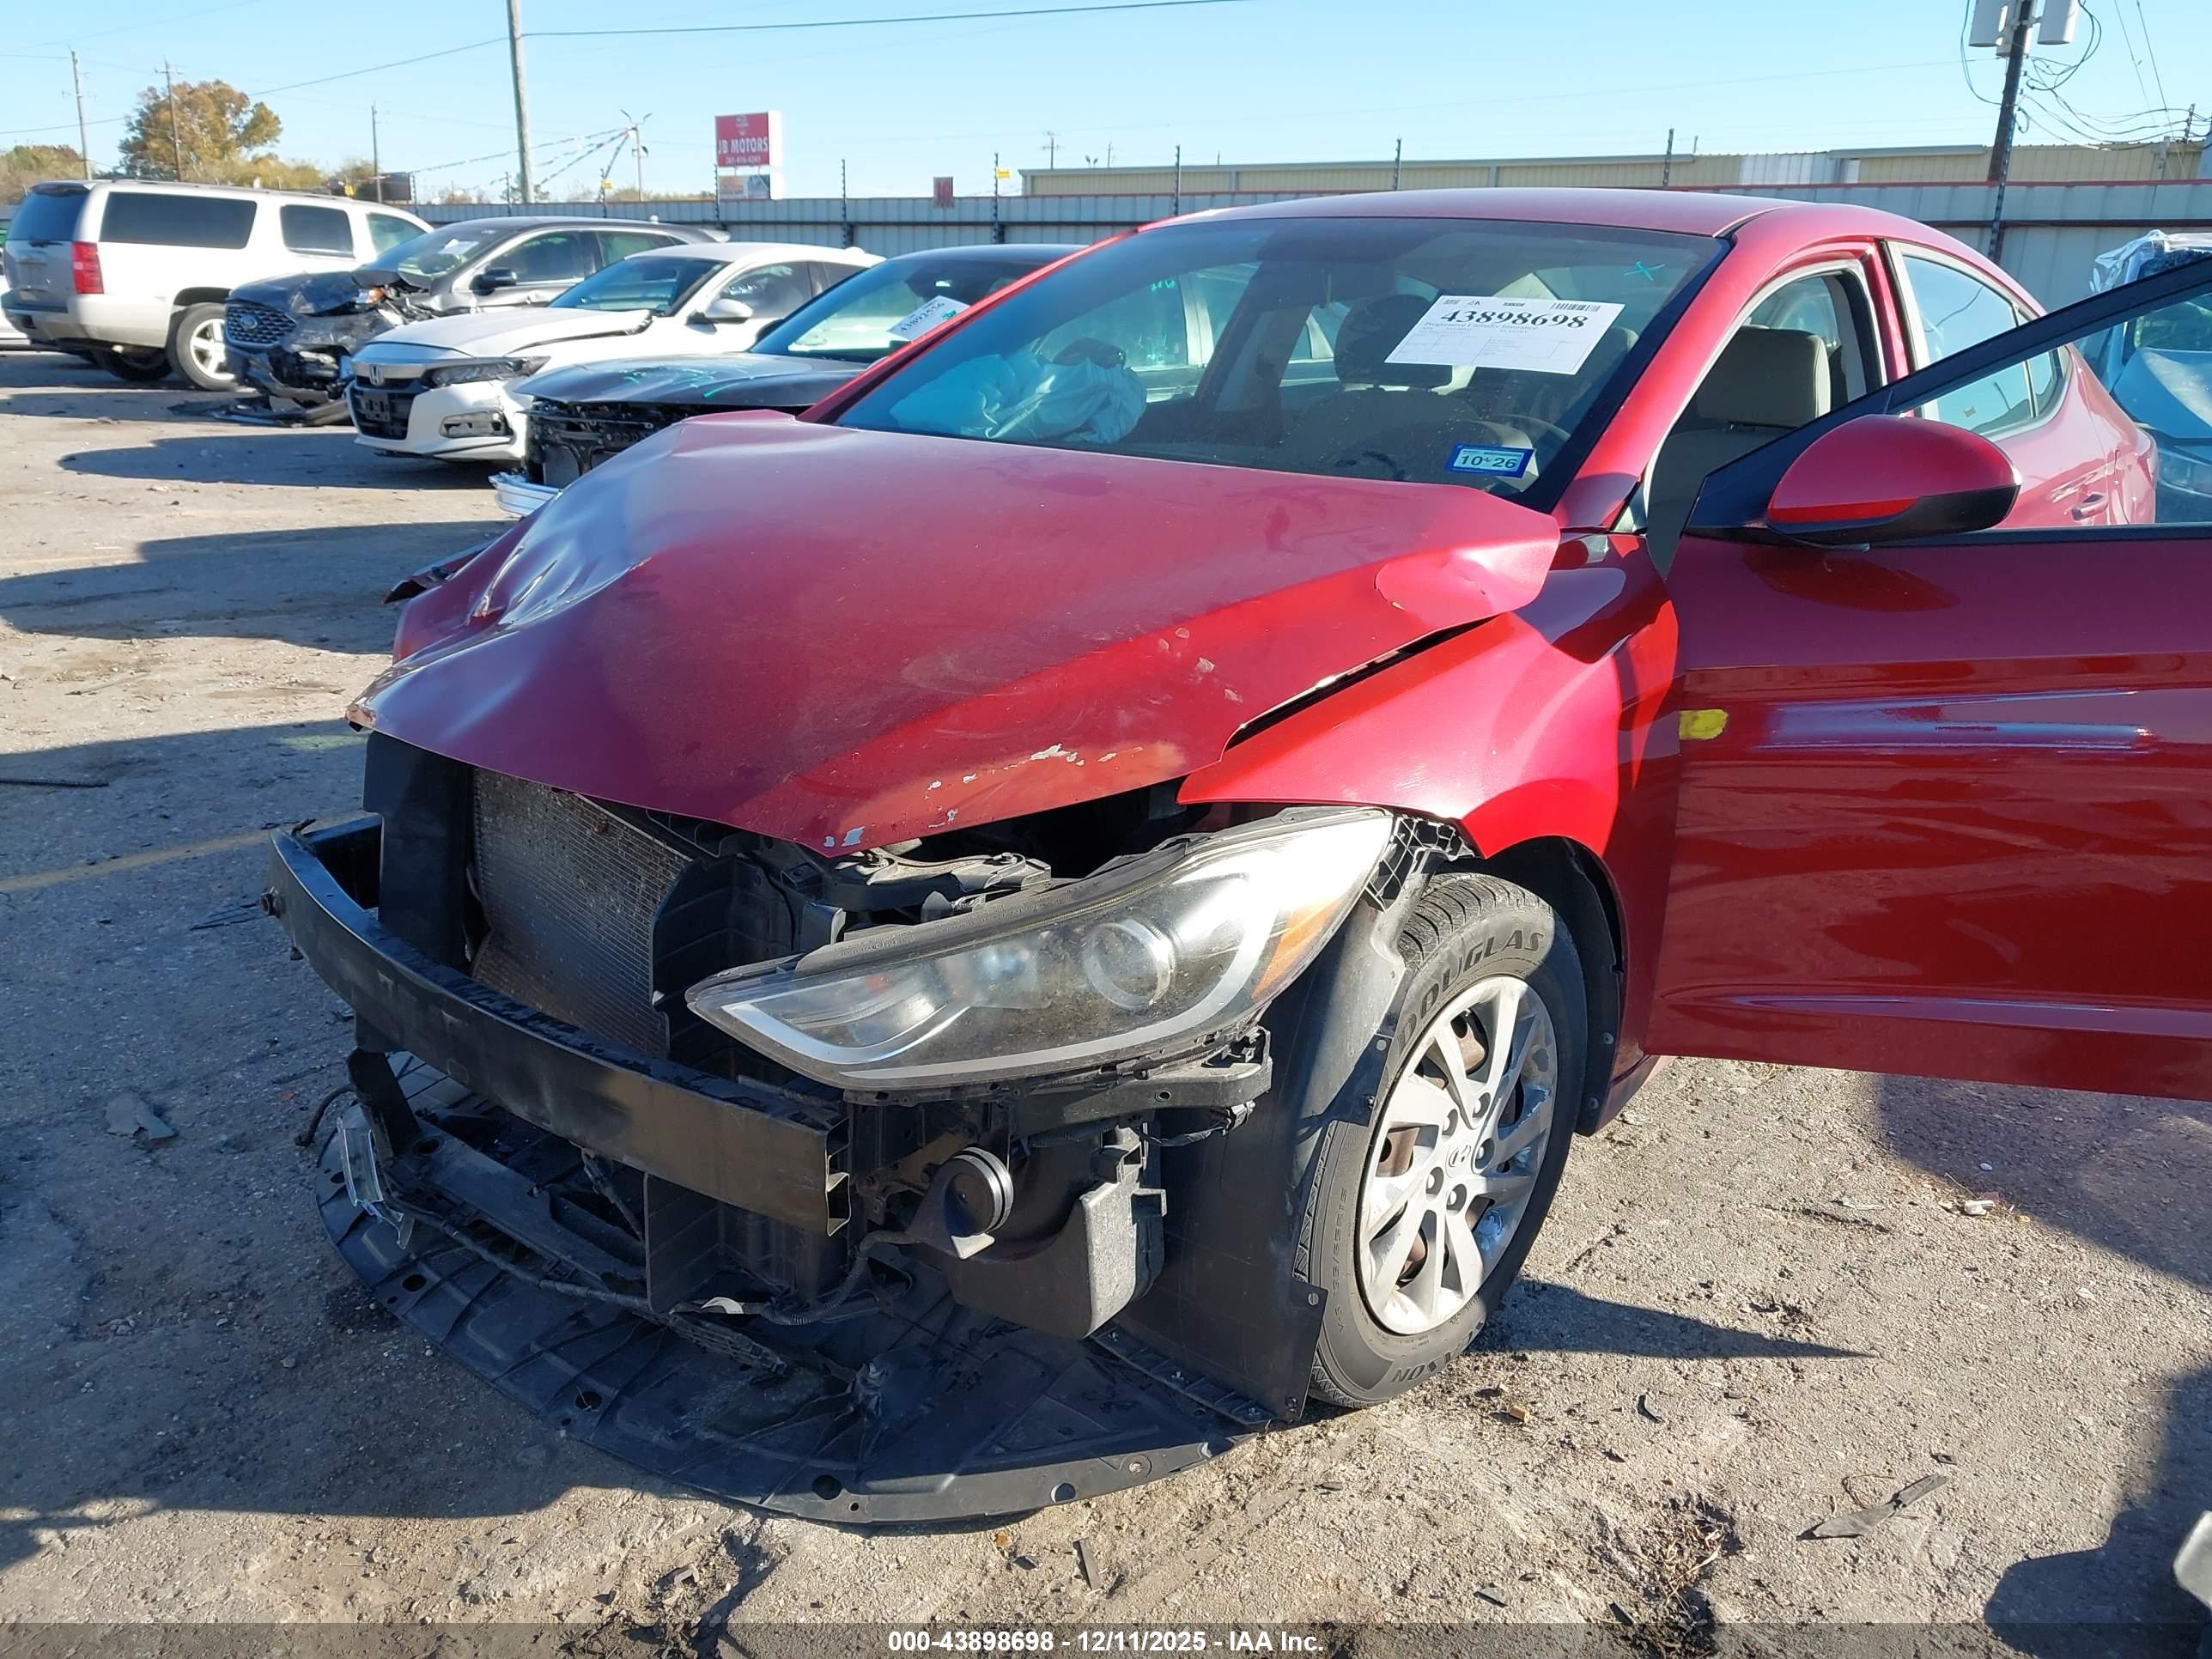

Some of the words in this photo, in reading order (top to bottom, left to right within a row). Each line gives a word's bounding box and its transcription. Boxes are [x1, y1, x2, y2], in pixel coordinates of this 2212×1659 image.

[718, 139, 728, 155] JB
[731, 137, 769, 154] MOTORS
[1440, 309, 1589, 328] 43898698
[1398, 929, 1545, 1054] DOUGLAS
